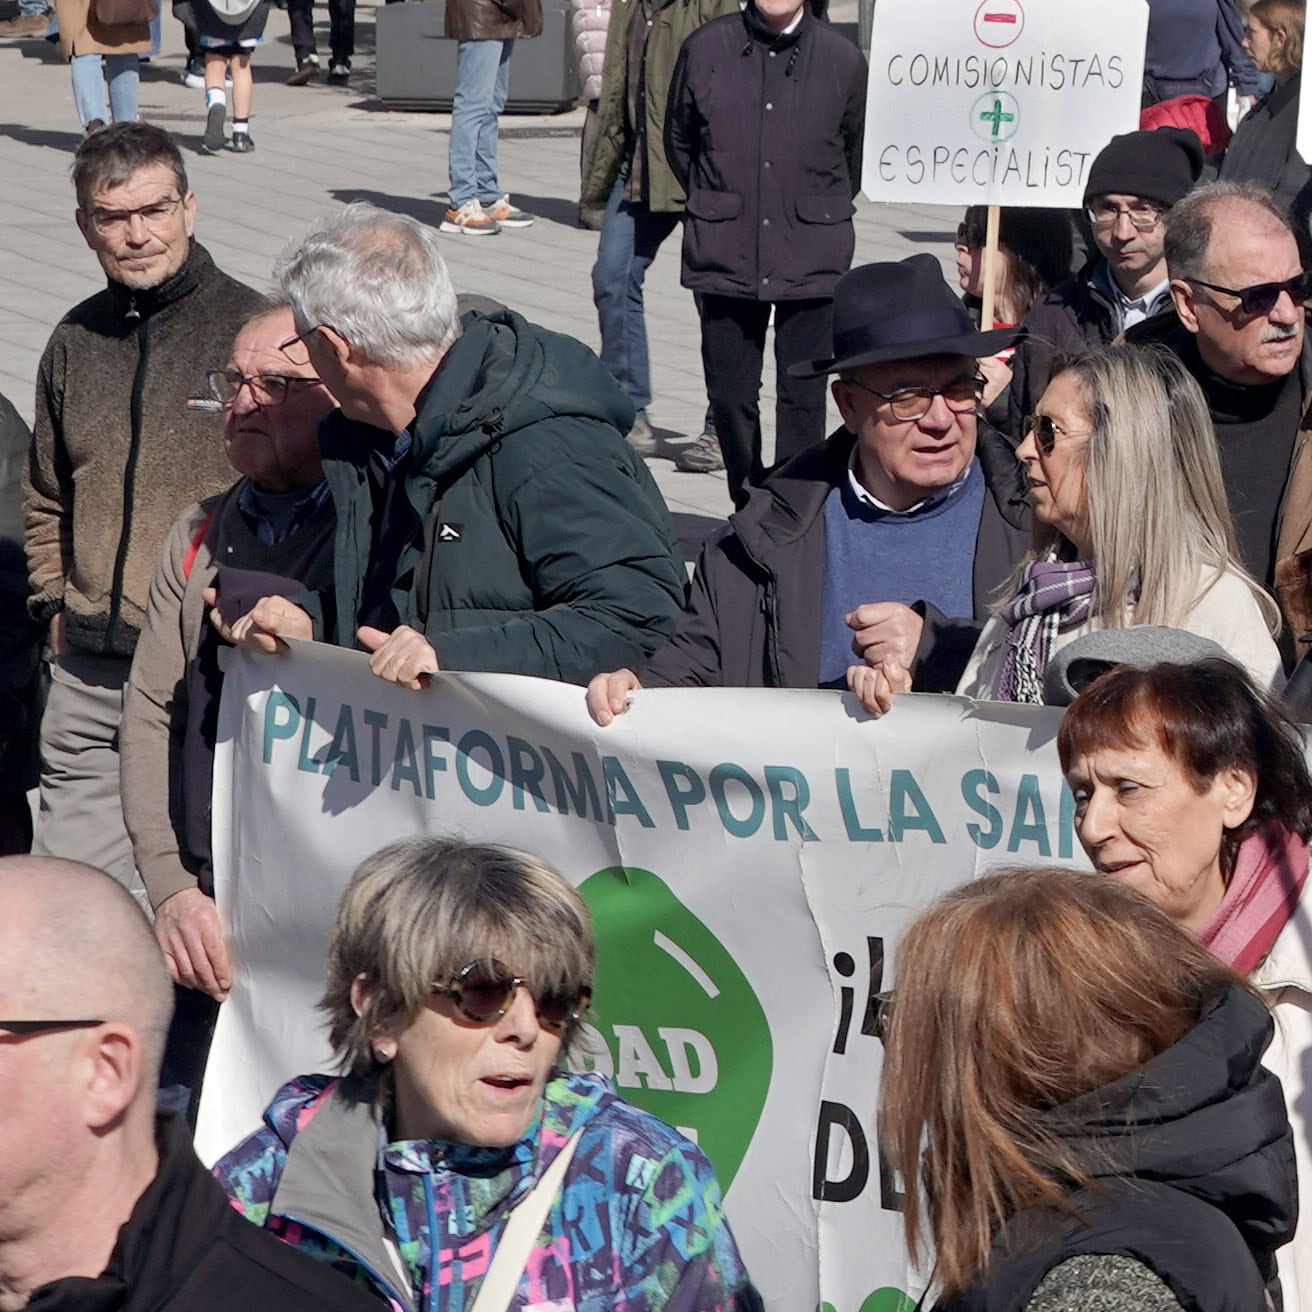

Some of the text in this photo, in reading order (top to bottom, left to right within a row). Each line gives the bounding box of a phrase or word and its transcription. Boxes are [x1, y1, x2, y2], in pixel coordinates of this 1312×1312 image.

[887, 49, 1125, 90] COMISIONISTAS
[879, 142, 1092, 188] ESPECIALIST
[262, 686, 656, 830] PLATAFORMA
[660, 760, 821, 844] POR
[834, 766, 948, 846] LA
